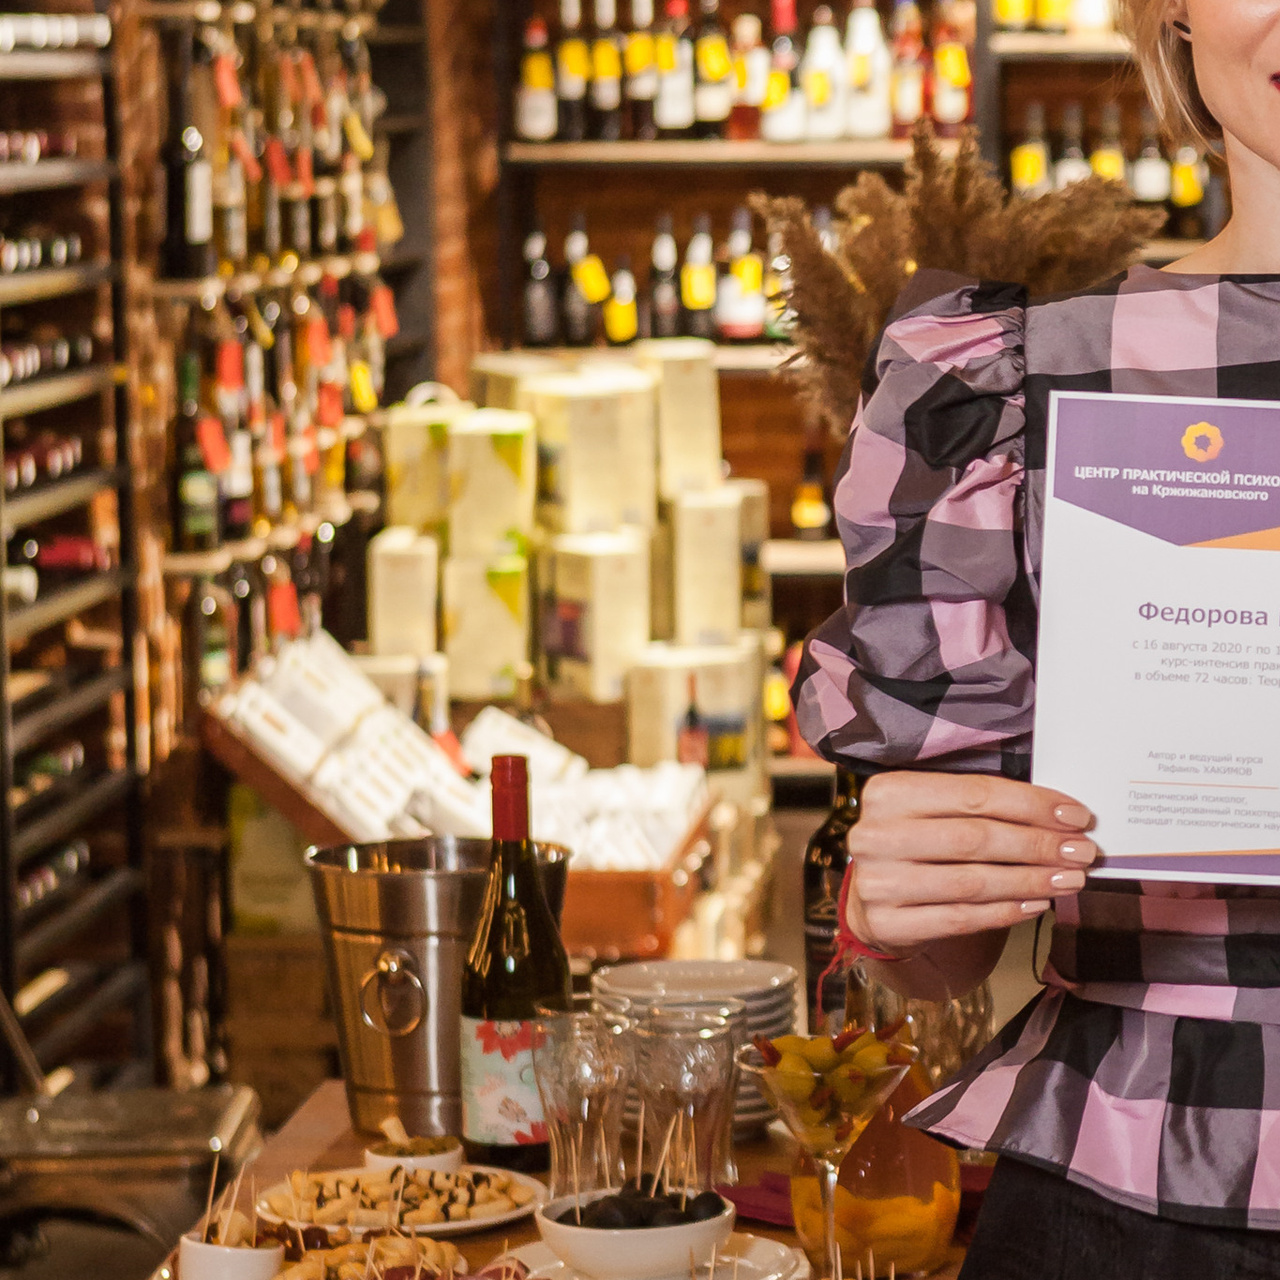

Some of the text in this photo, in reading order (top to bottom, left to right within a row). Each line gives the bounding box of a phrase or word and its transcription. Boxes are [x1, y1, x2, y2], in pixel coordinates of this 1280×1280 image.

[1074, 466, 1120, 480] ЦЕНТР
[1122, 467, 1231, 485] ПРАКТИЧЕСКОЙ
[1132, 484, 1269, 501] на Кржижановского
[1138, 601, 1269, 628] Федорова
[1143, 639, 1158, 651] 16
[1161, 641, 1208, 654] августа
[1211, 642, 1242, 654] 2020
[1256, 645, 1271, 655] по
[1160, 657, 1250, 670] курс-интенсив
[1145, 670, 1190, 683] объеме
[1193, 672, 1210, 683] 72
[1147, 750, 1177, 762] Автор
[1189, 754, 1233, 765] ведущий
[1235, 757, 1264, 765] курса
[1128, 790, 1248, 806] Практический психолог,
[1127, 803, 1231, 817] сертифицированный
[1176, 817, 1260, 830] психологических
